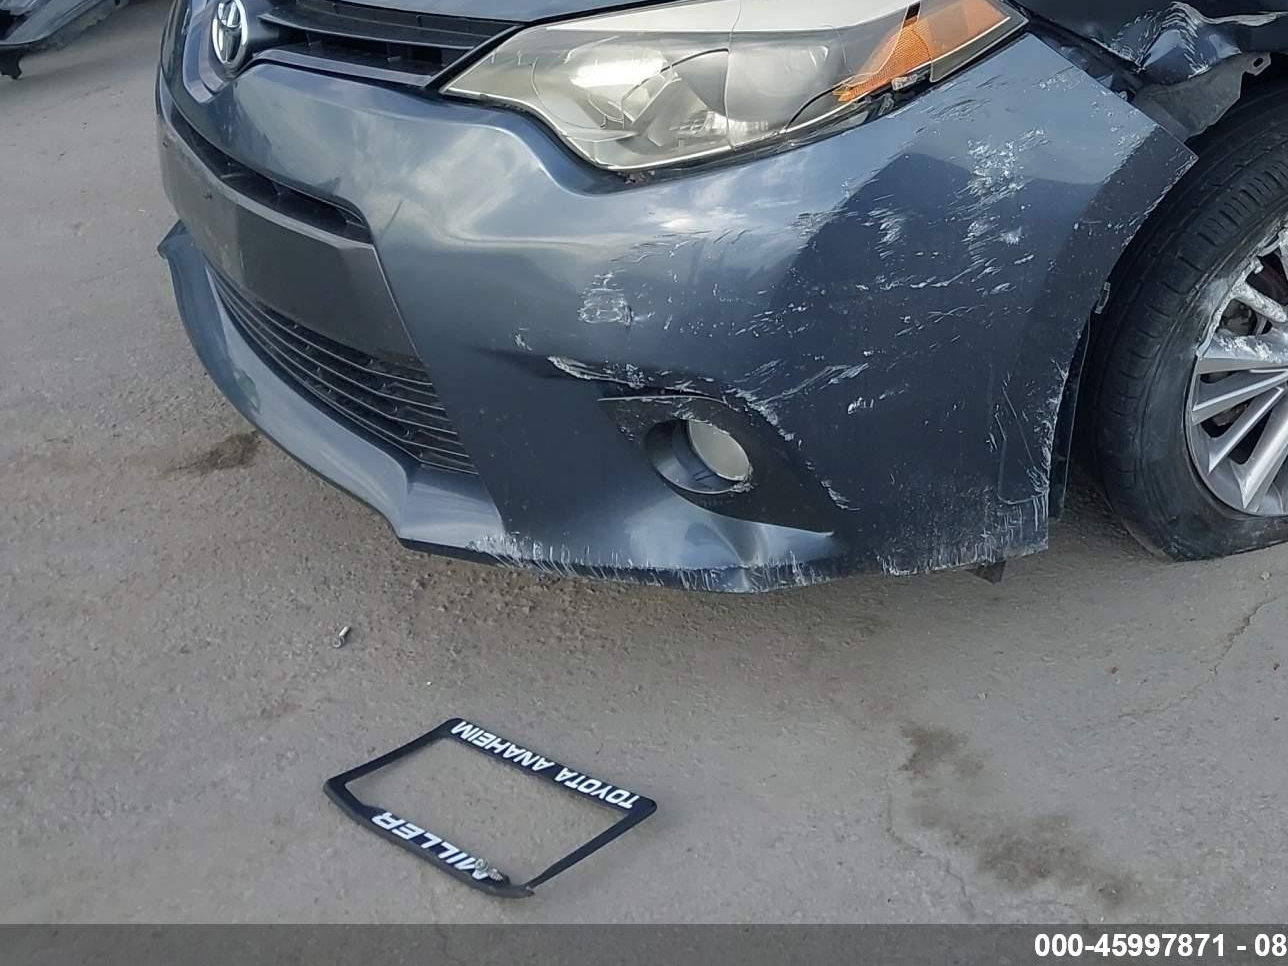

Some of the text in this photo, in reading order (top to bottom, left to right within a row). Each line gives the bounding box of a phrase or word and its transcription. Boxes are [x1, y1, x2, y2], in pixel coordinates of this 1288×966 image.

[450, 720, 640, 809] TOYOTA ANAHEIM
[372, 812, 488, 880] MILLER
